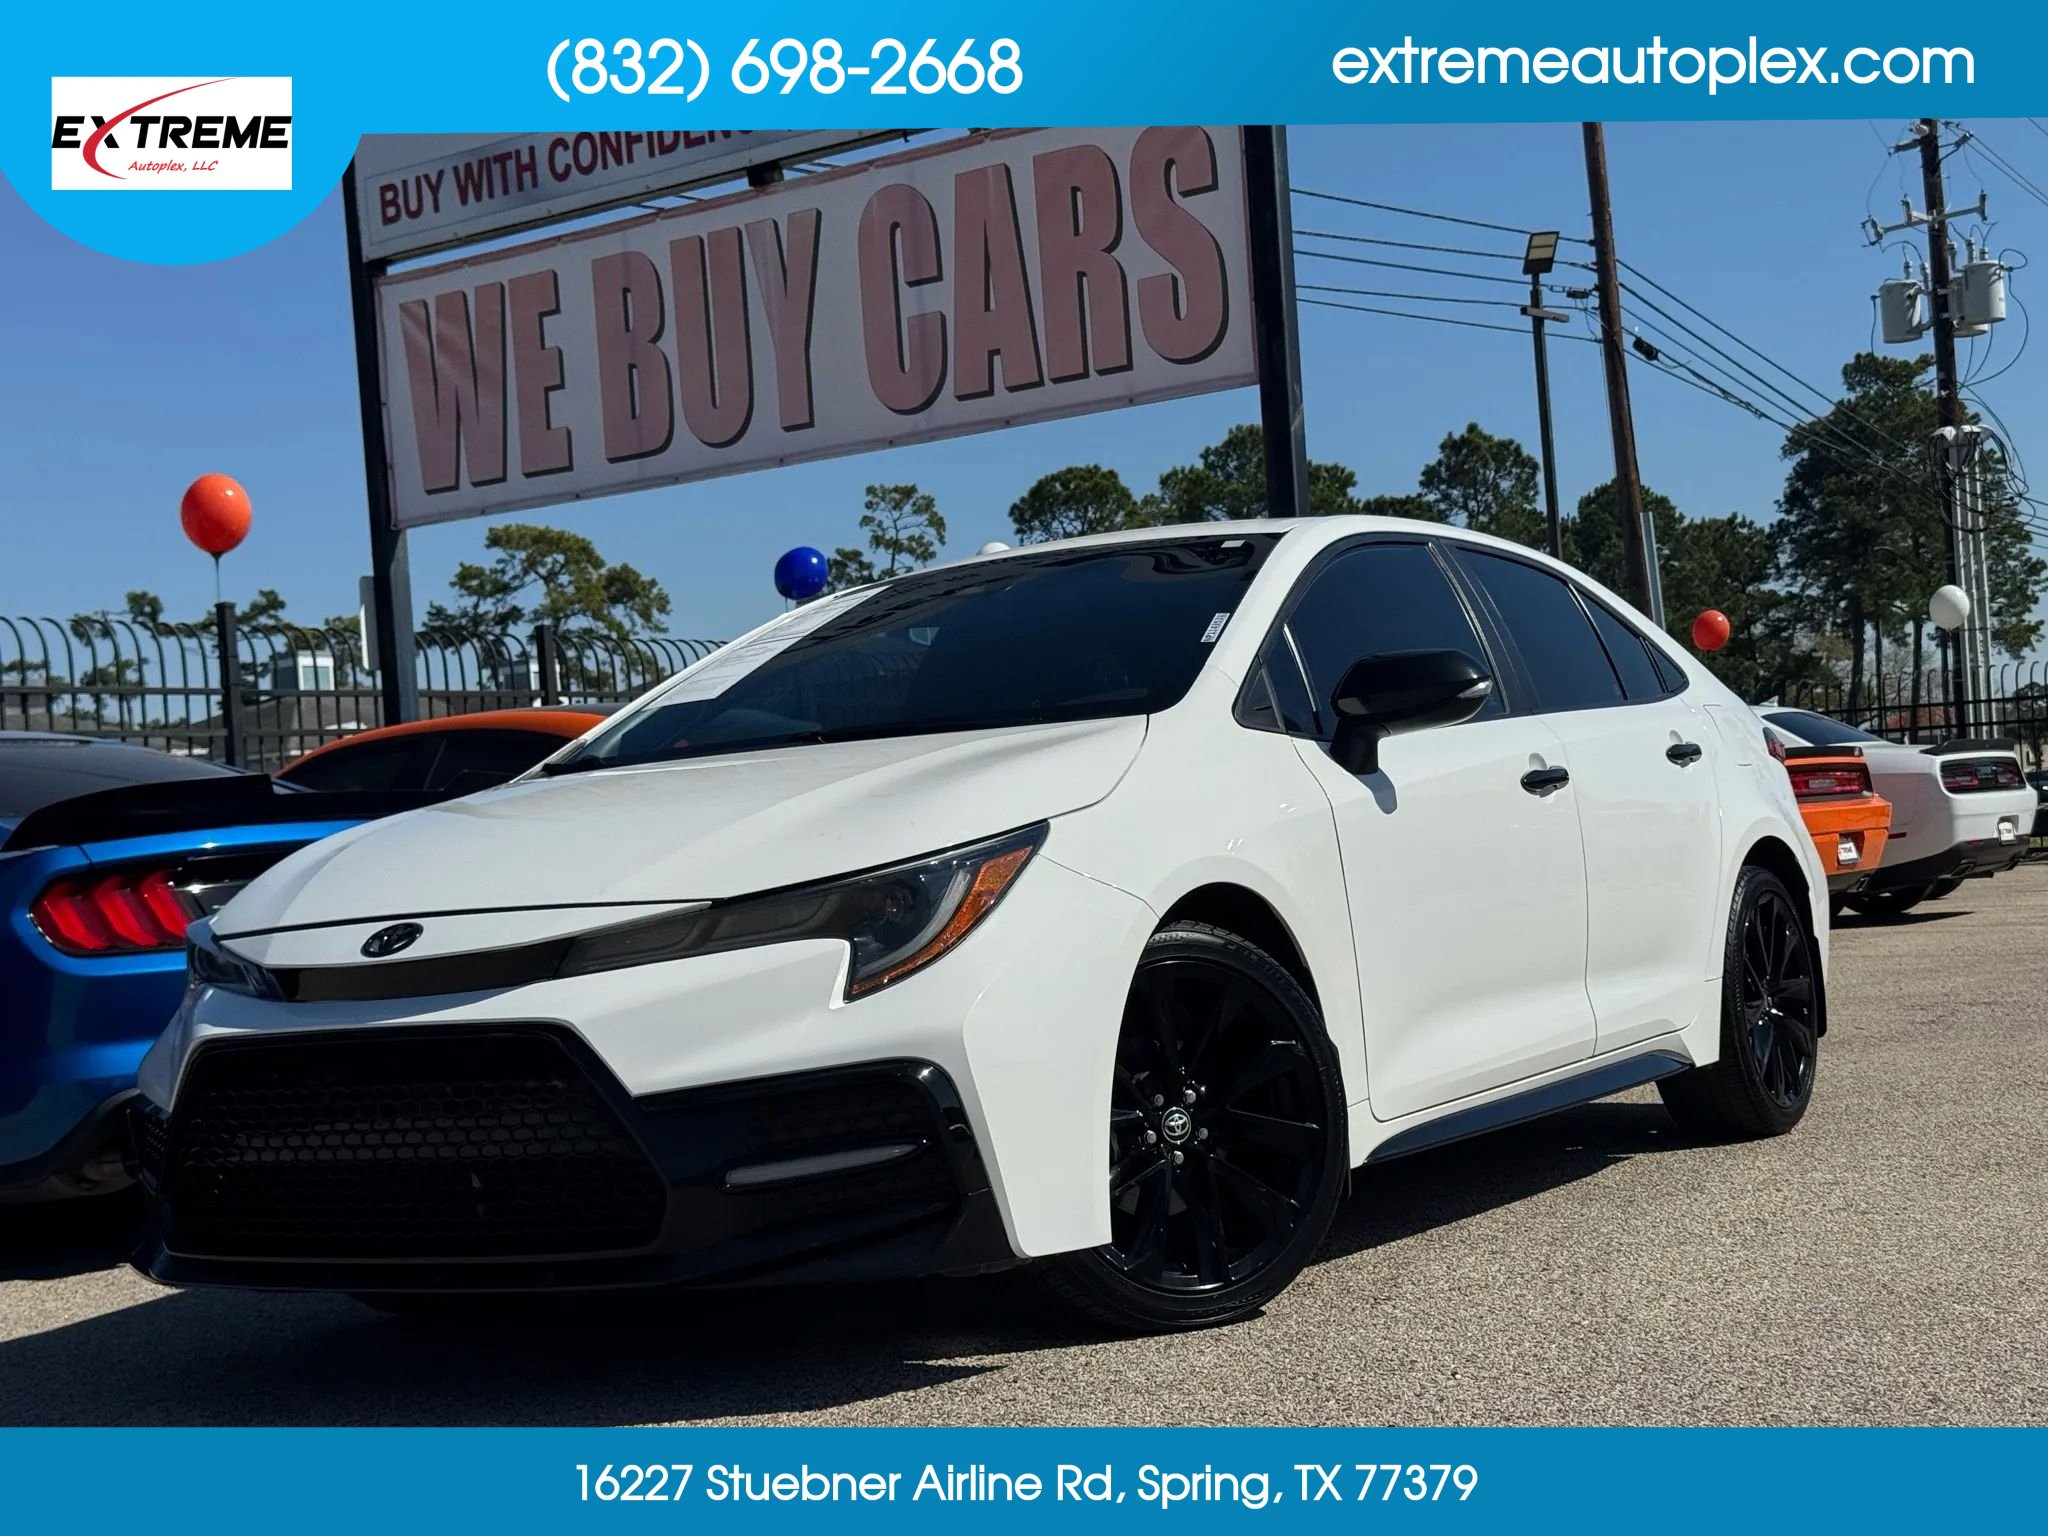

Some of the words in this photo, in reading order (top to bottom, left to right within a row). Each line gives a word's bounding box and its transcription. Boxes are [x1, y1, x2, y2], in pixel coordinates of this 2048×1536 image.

[379, 168, 445, 227] BUY
[452, 145, 539, 207] WITH
[398, 269, 574, 496] WE
[591, 207, 822, 464] BUY
[858, 125, 1230, 416] CARS
